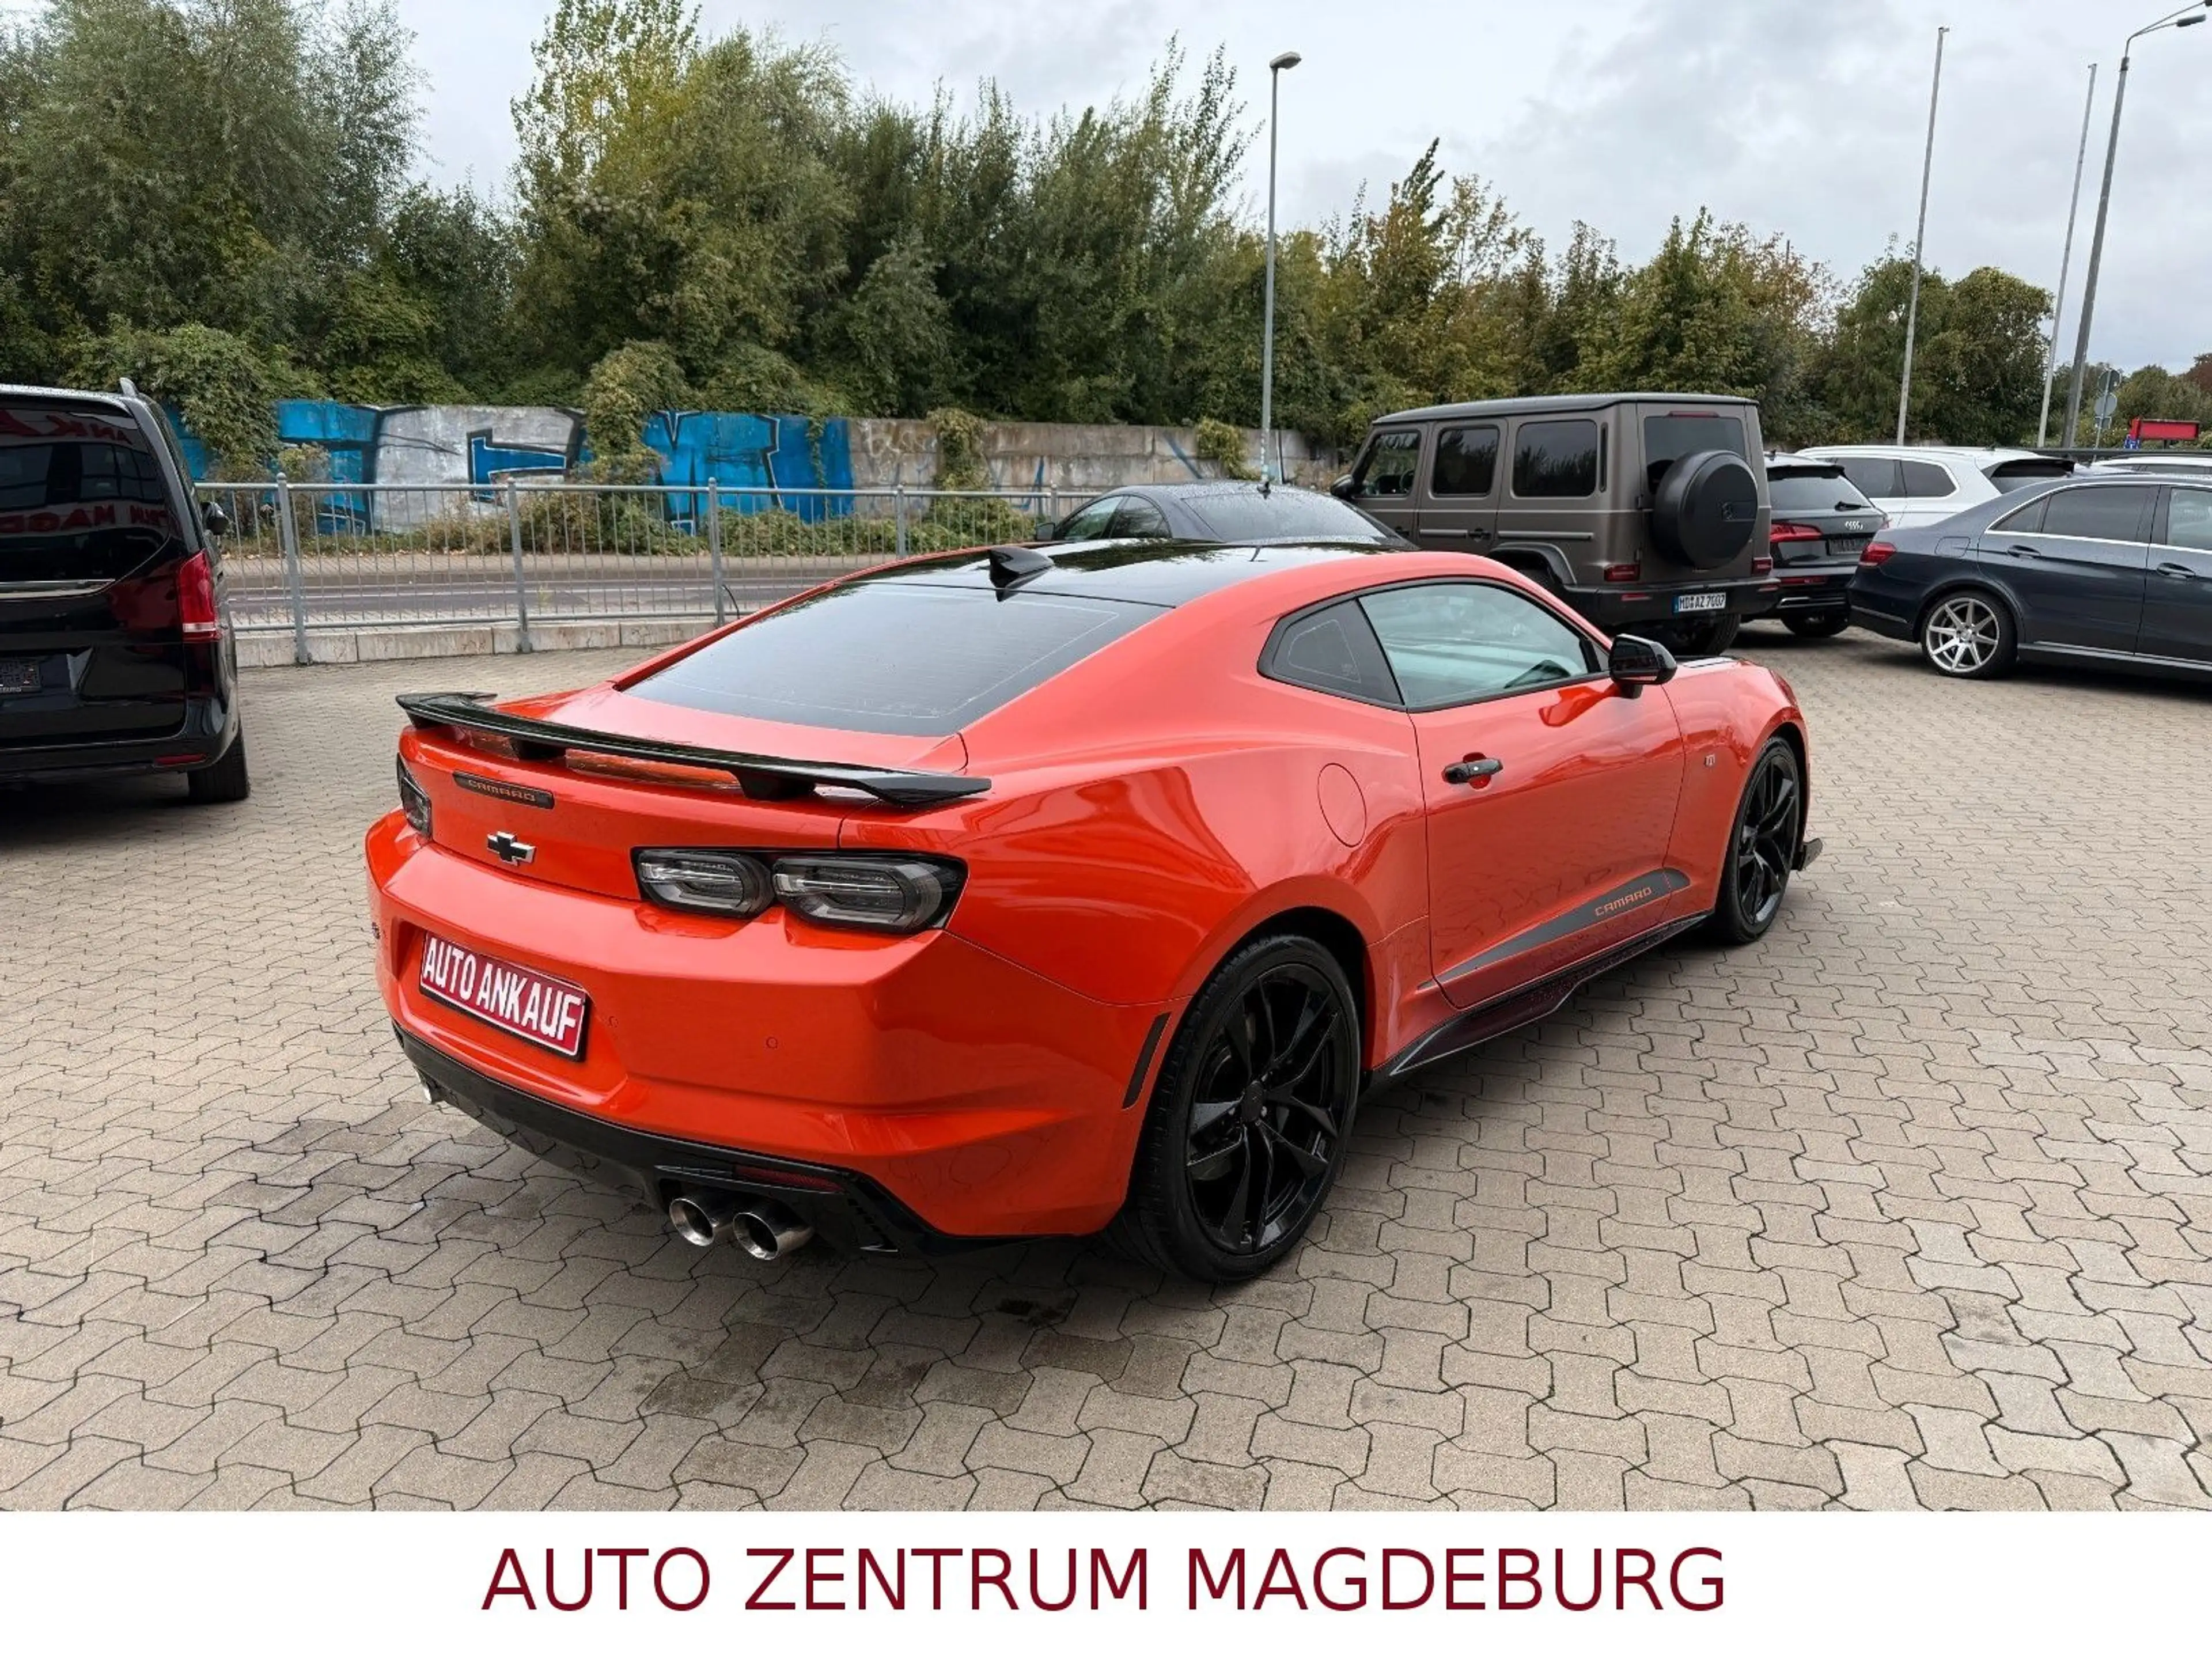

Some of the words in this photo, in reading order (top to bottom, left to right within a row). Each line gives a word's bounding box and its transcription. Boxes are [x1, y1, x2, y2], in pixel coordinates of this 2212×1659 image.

[468, 779, 536, 802] CAMARO
[1594, 887, 1652, 916] CAMARO
[423, 937, 477, 1001] AUTO
[475, 962, 582, 1041] ANKAUF
